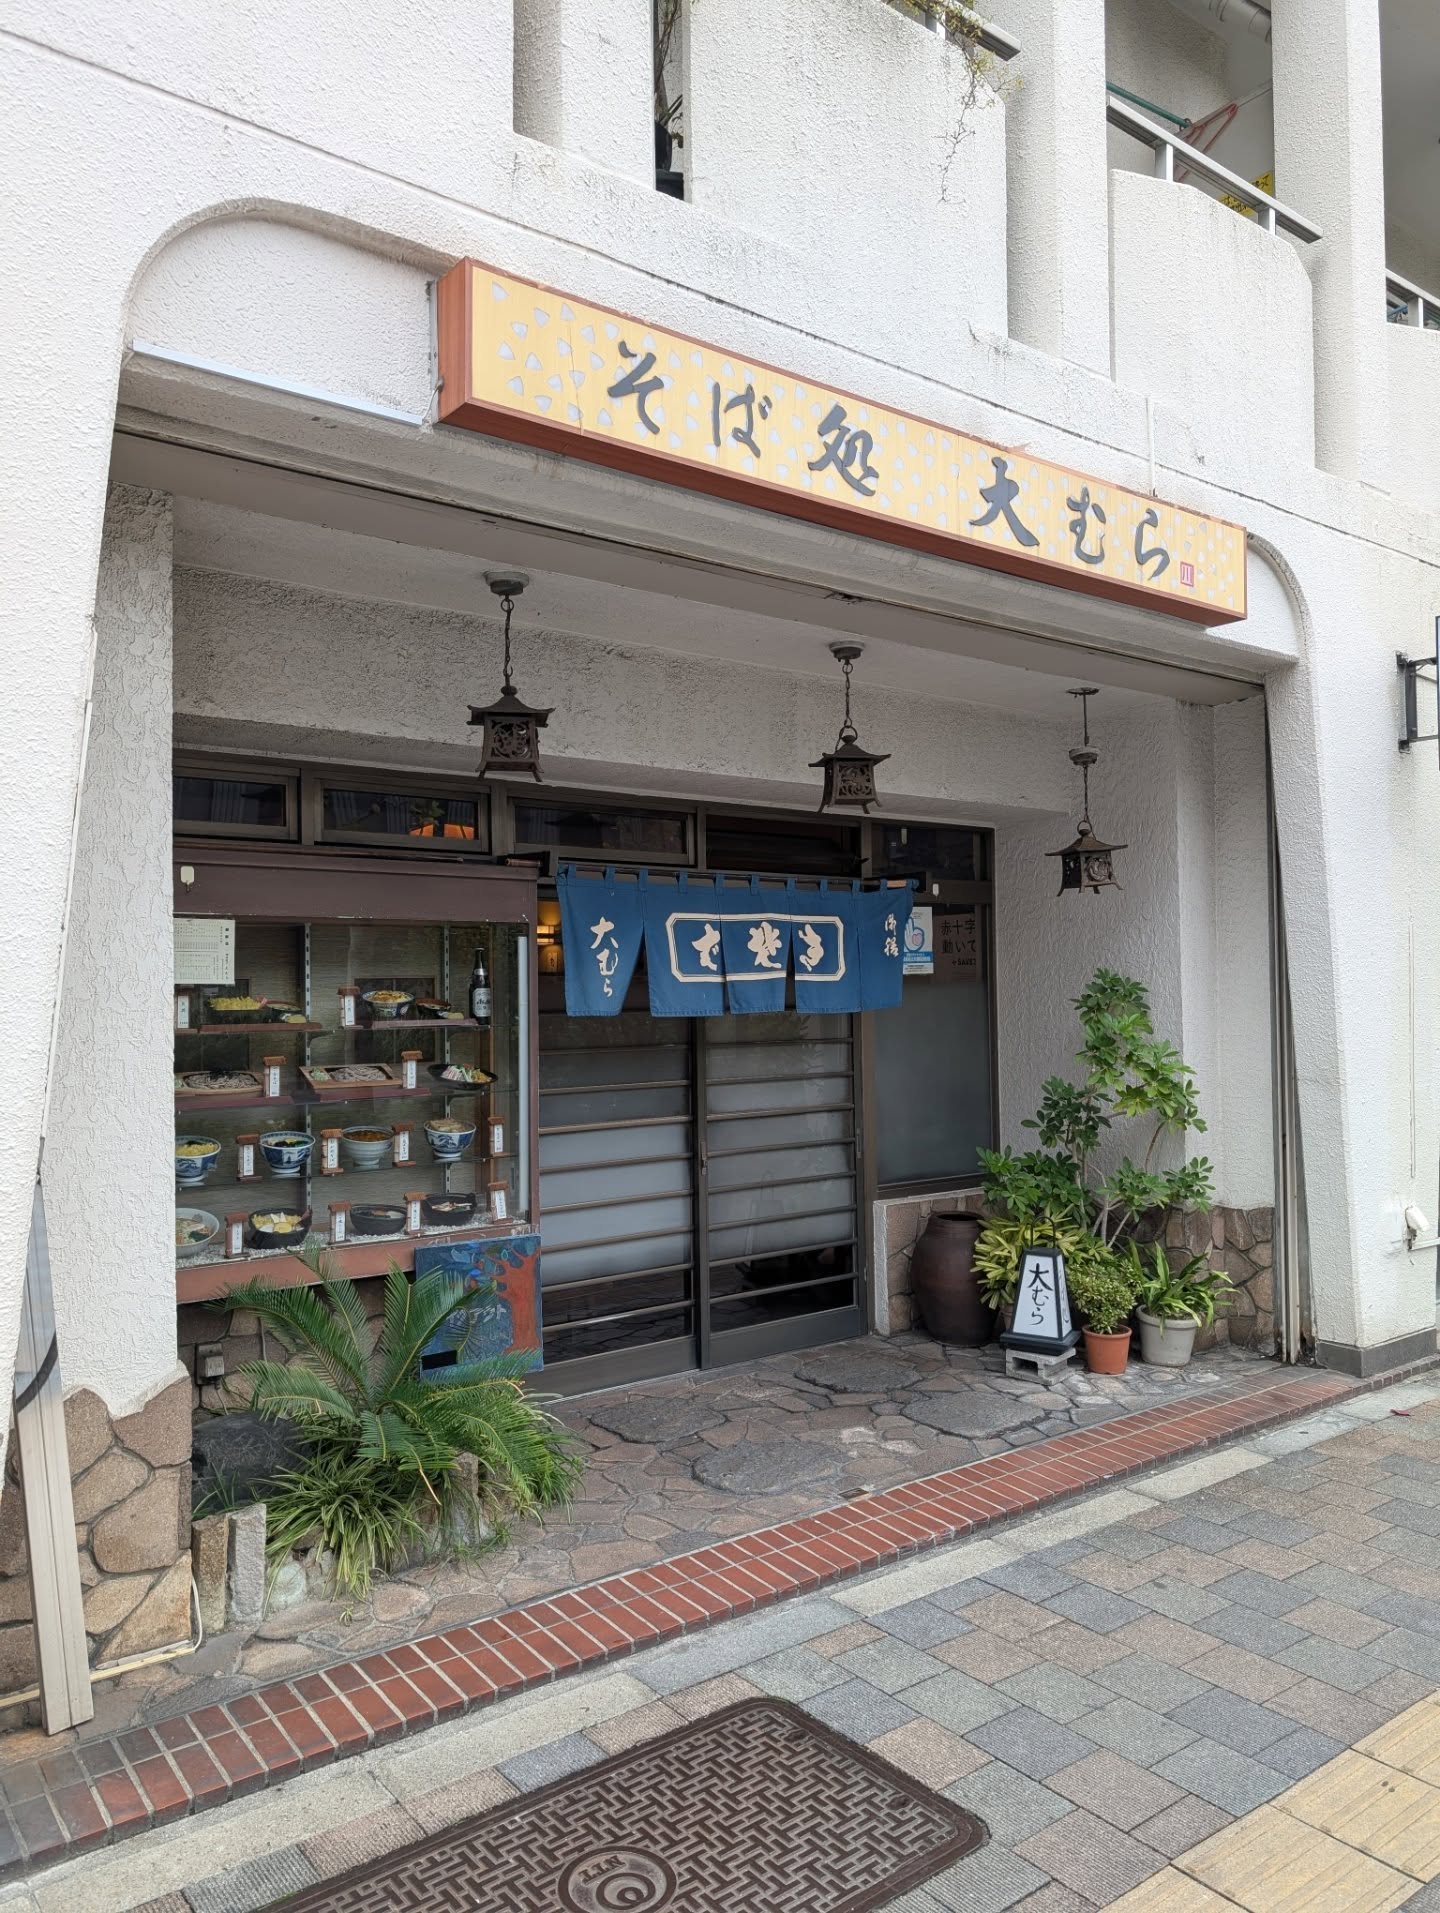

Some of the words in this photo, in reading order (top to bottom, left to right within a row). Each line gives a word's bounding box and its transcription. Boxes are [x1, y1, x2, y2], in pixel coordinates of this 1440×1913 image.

[608, 340, 878, 497] そば処
[970, 456, 1169, 580] 大むら
[590, 916, 619, 998] 大むら
[1027, 1262, 1054, 1326] 大むら
[578, 1854, 626, 1885] NTT
